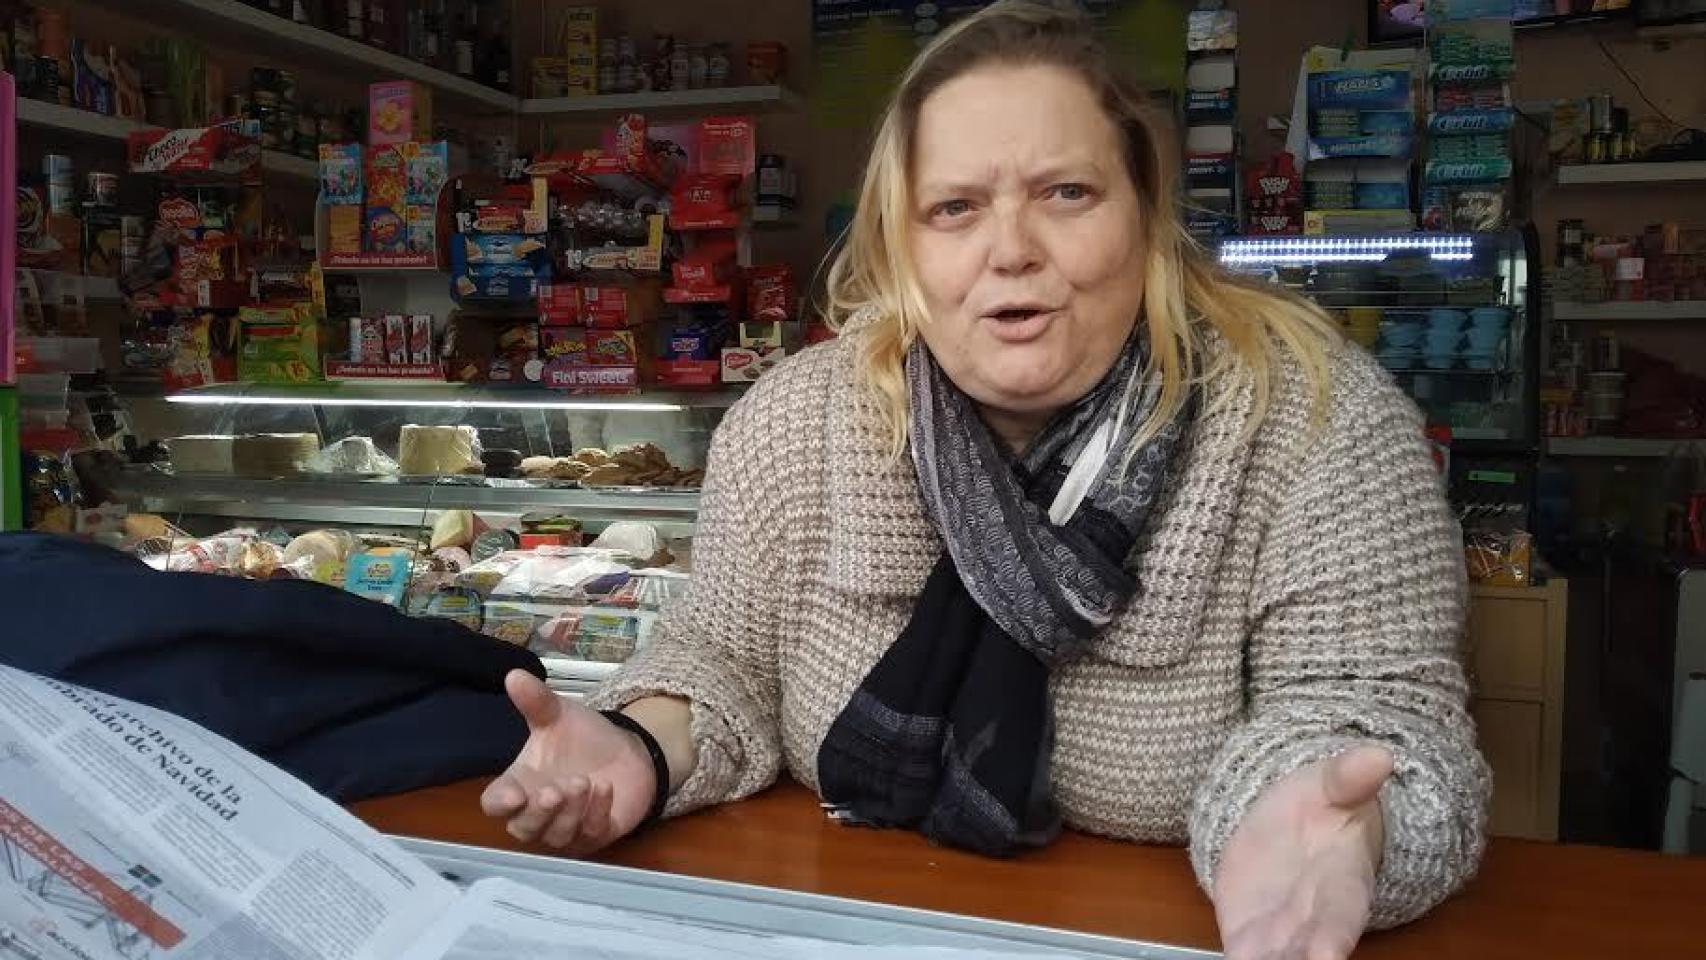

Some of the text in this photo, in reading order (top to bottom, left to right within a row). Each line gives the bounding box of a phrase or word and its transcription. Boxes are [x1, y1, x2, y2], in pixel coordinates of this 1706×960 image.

[115, 711, 193, 766] archivo
[193, 763, 222, 788] de
[220, 784, 241, 805] la
[124, 733, 153, 755] de
[153, 752, 239, 822] Navidad
